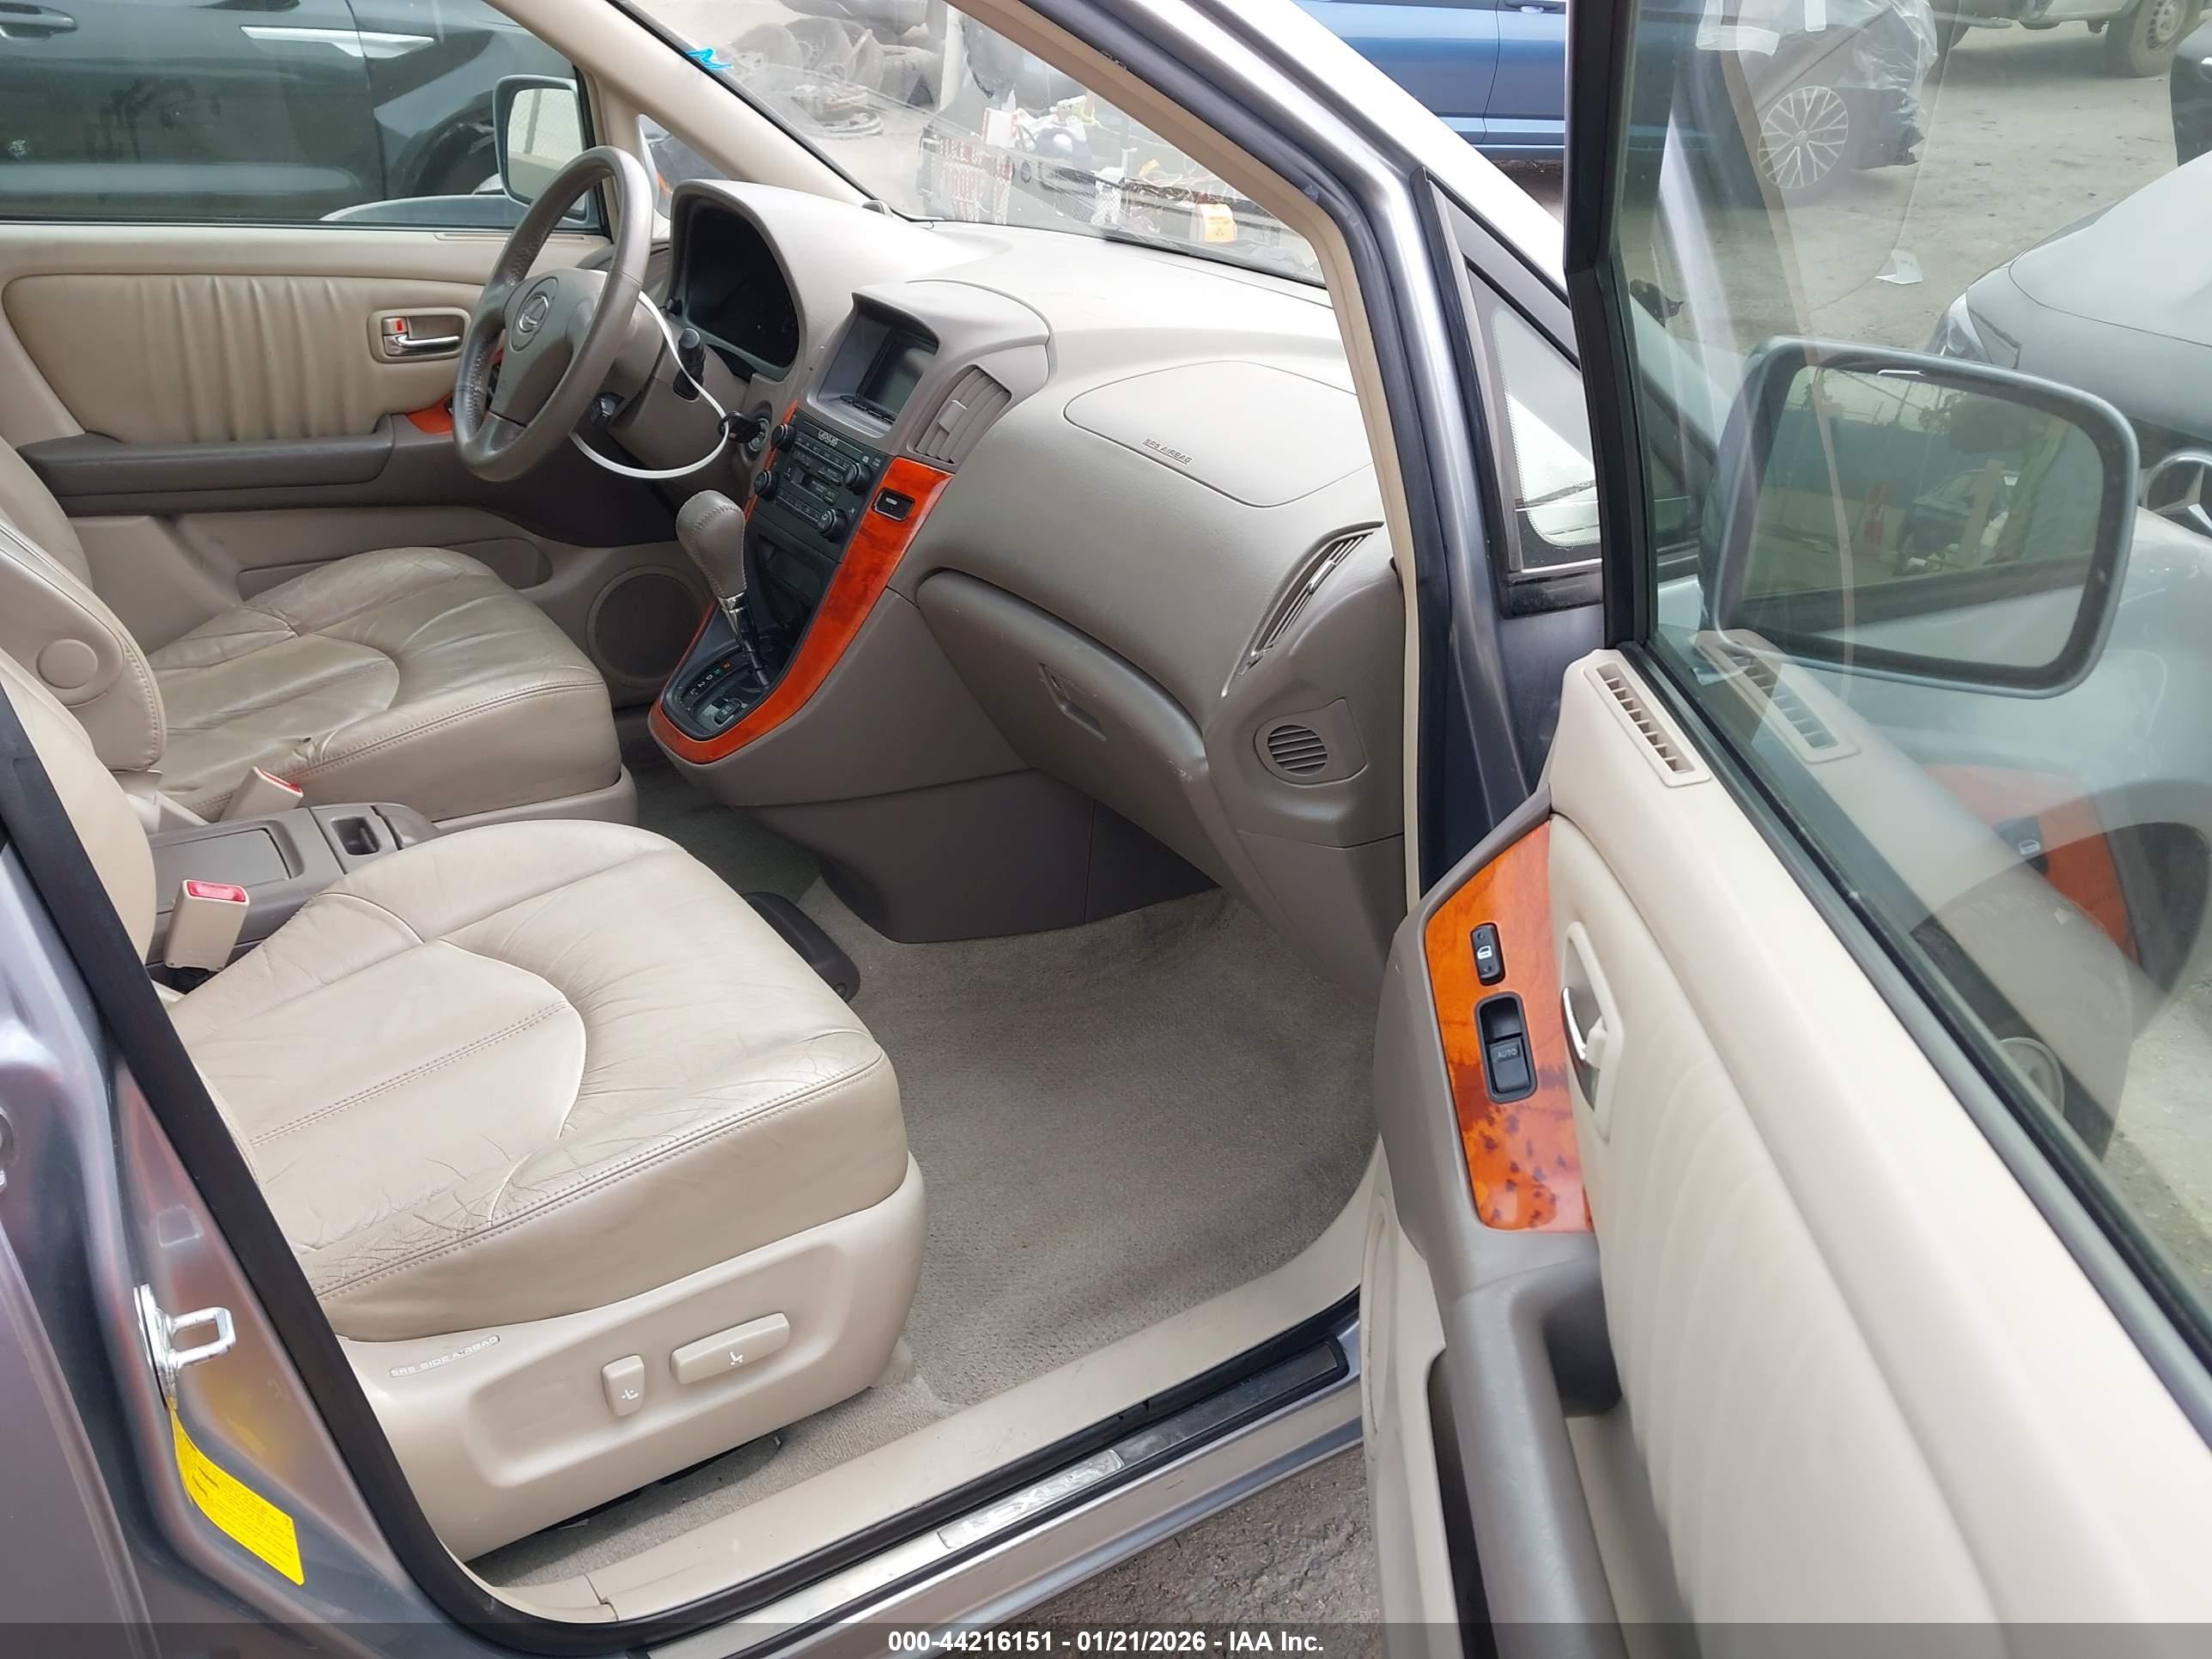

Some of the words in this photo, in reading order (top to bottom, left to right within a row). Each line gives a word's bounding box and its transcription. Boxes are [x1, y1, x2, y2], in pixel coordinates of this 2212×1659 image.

[817, 430, 839, 445] LEXUS
[1159, 446, 1193, 463] AIRBAG
[1497, 1048, 1517, 1058] AUTO
